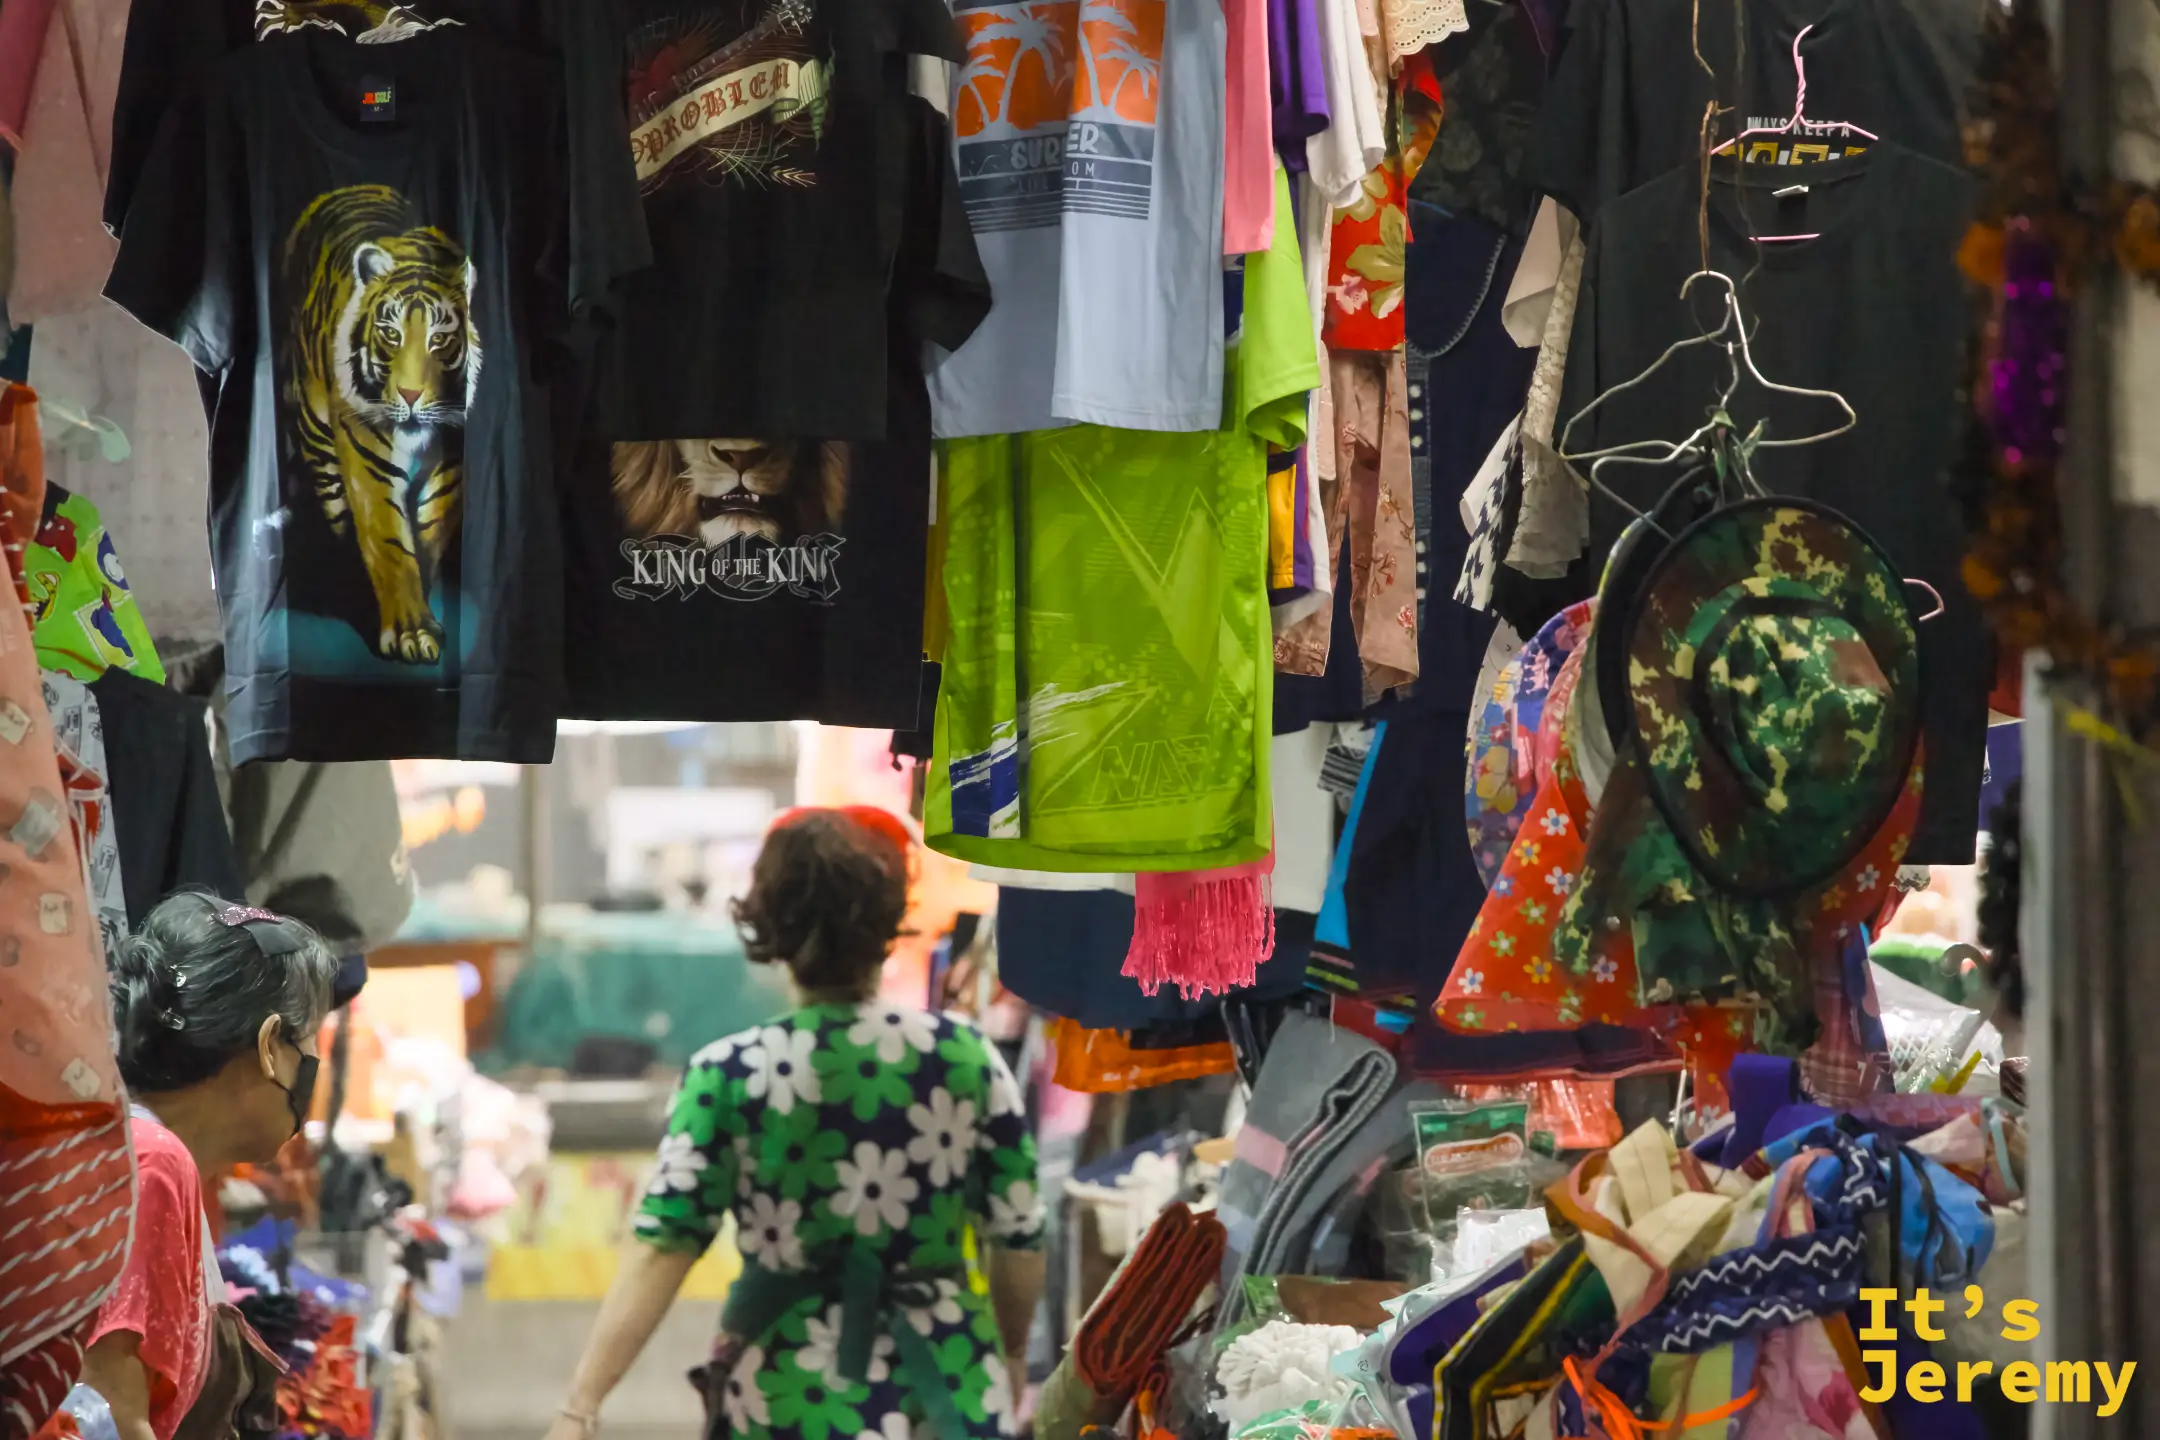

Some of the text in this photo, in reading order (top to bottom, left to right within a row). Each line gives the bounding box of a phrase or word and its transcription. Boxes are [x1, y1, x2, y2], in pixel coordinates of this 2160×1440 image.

[631, 548, 706, 585] KING
[712, 558, 730, 576] OF
[733, 558, 762, 577] THE
